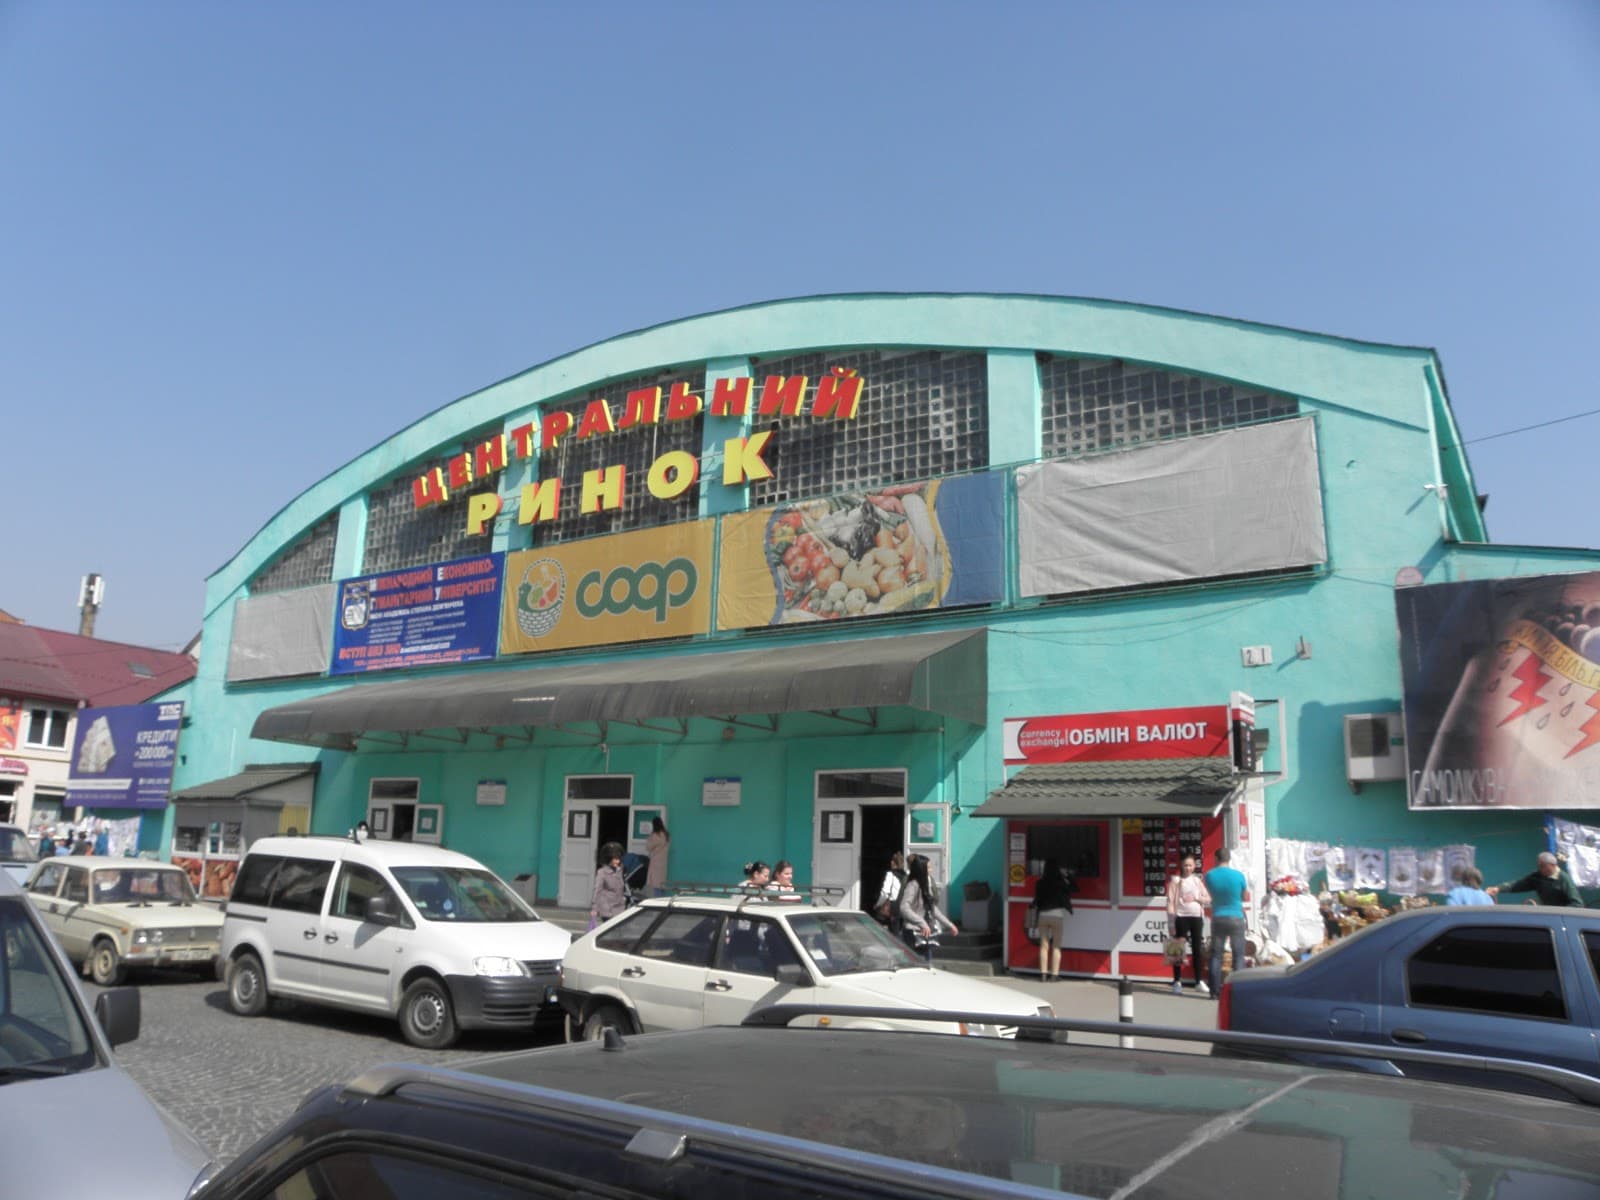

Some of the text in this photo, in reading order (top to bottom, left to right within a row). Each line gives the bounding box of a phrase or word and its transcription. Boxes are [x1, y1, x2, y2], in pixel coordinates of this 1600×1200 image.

[412, 366, 864, 509] ЦЕНТРАЛЬНИЙ
[467, 430, 775, 536] РИНОК
[1020, 729, 1061, 738] currency
[1069, 721, 1208, 746] ОБМІН ВАЛЮТ
